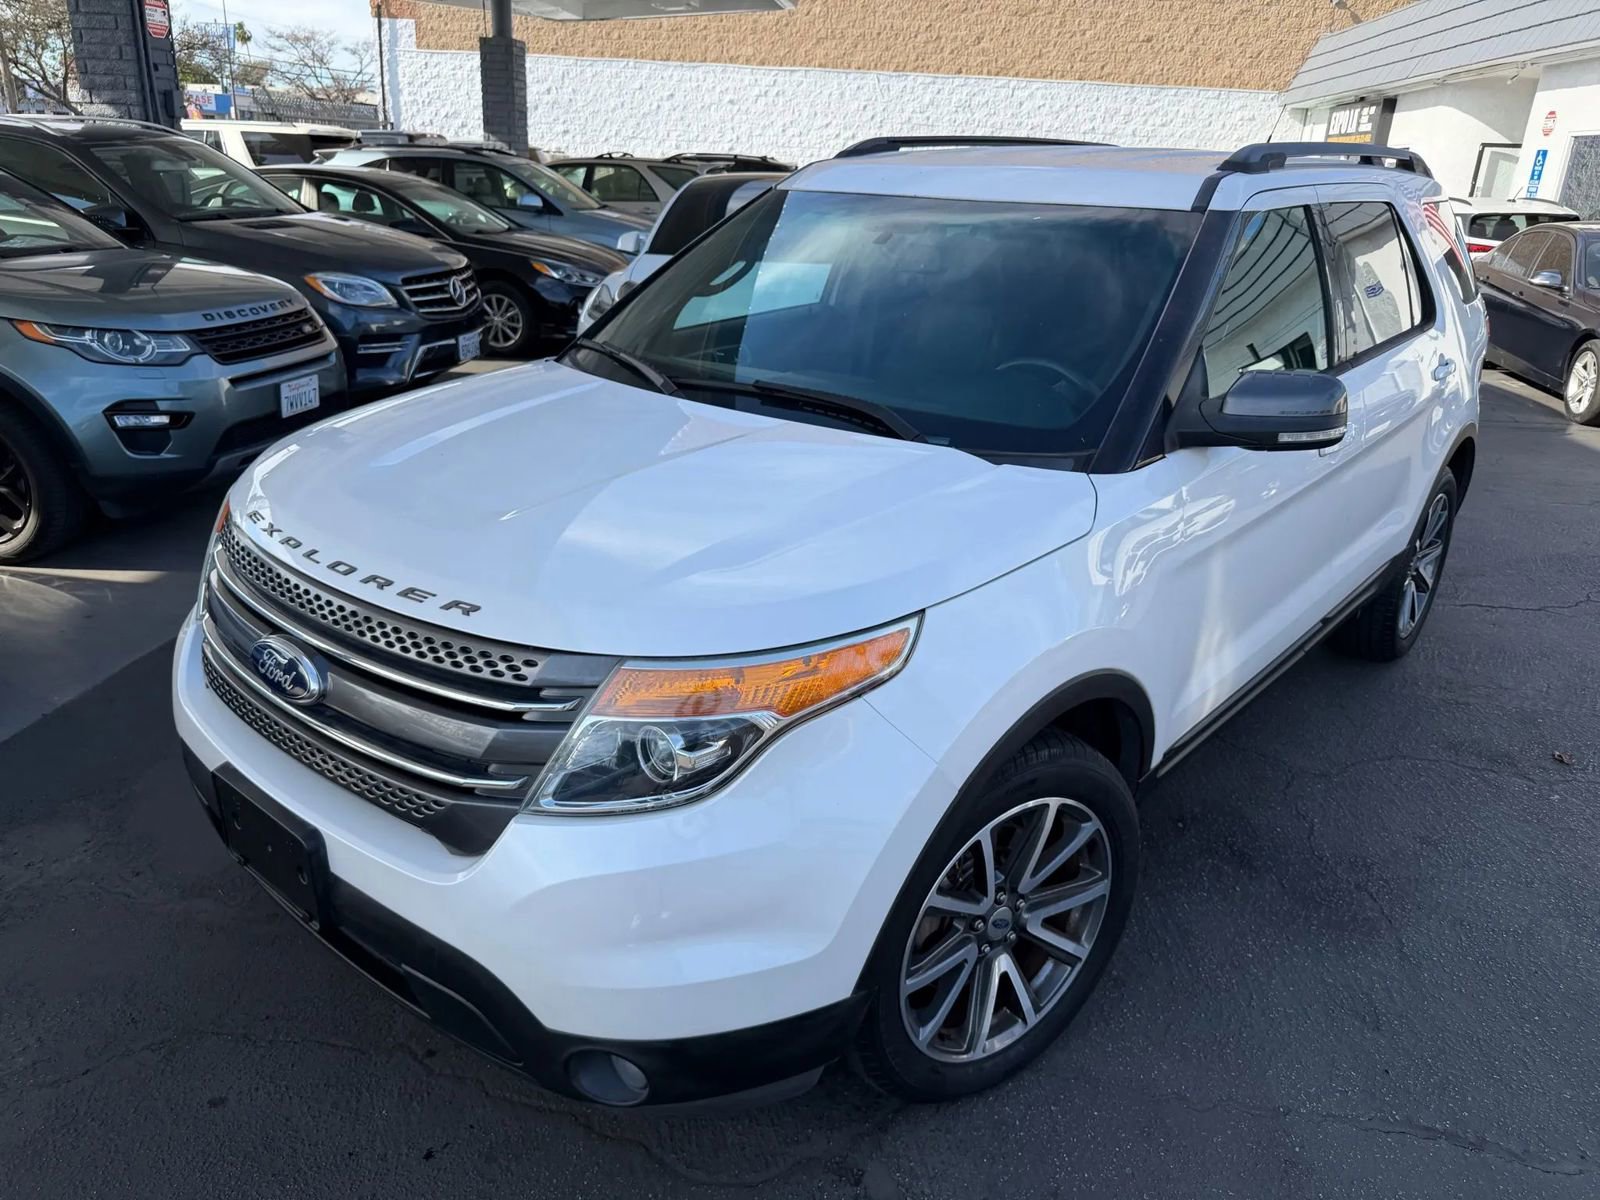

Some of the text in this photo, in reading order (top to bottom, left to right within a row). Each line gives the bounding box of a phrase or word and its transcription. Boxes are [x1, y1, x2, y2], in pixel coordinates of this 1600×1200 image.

[202, 298, 295, 321] DISCOVERY
[284, 388, 317, 413] 7WVV147
[248, 510, 482, 616] EXPLORER
[258, 648, 294, 691] Ford
